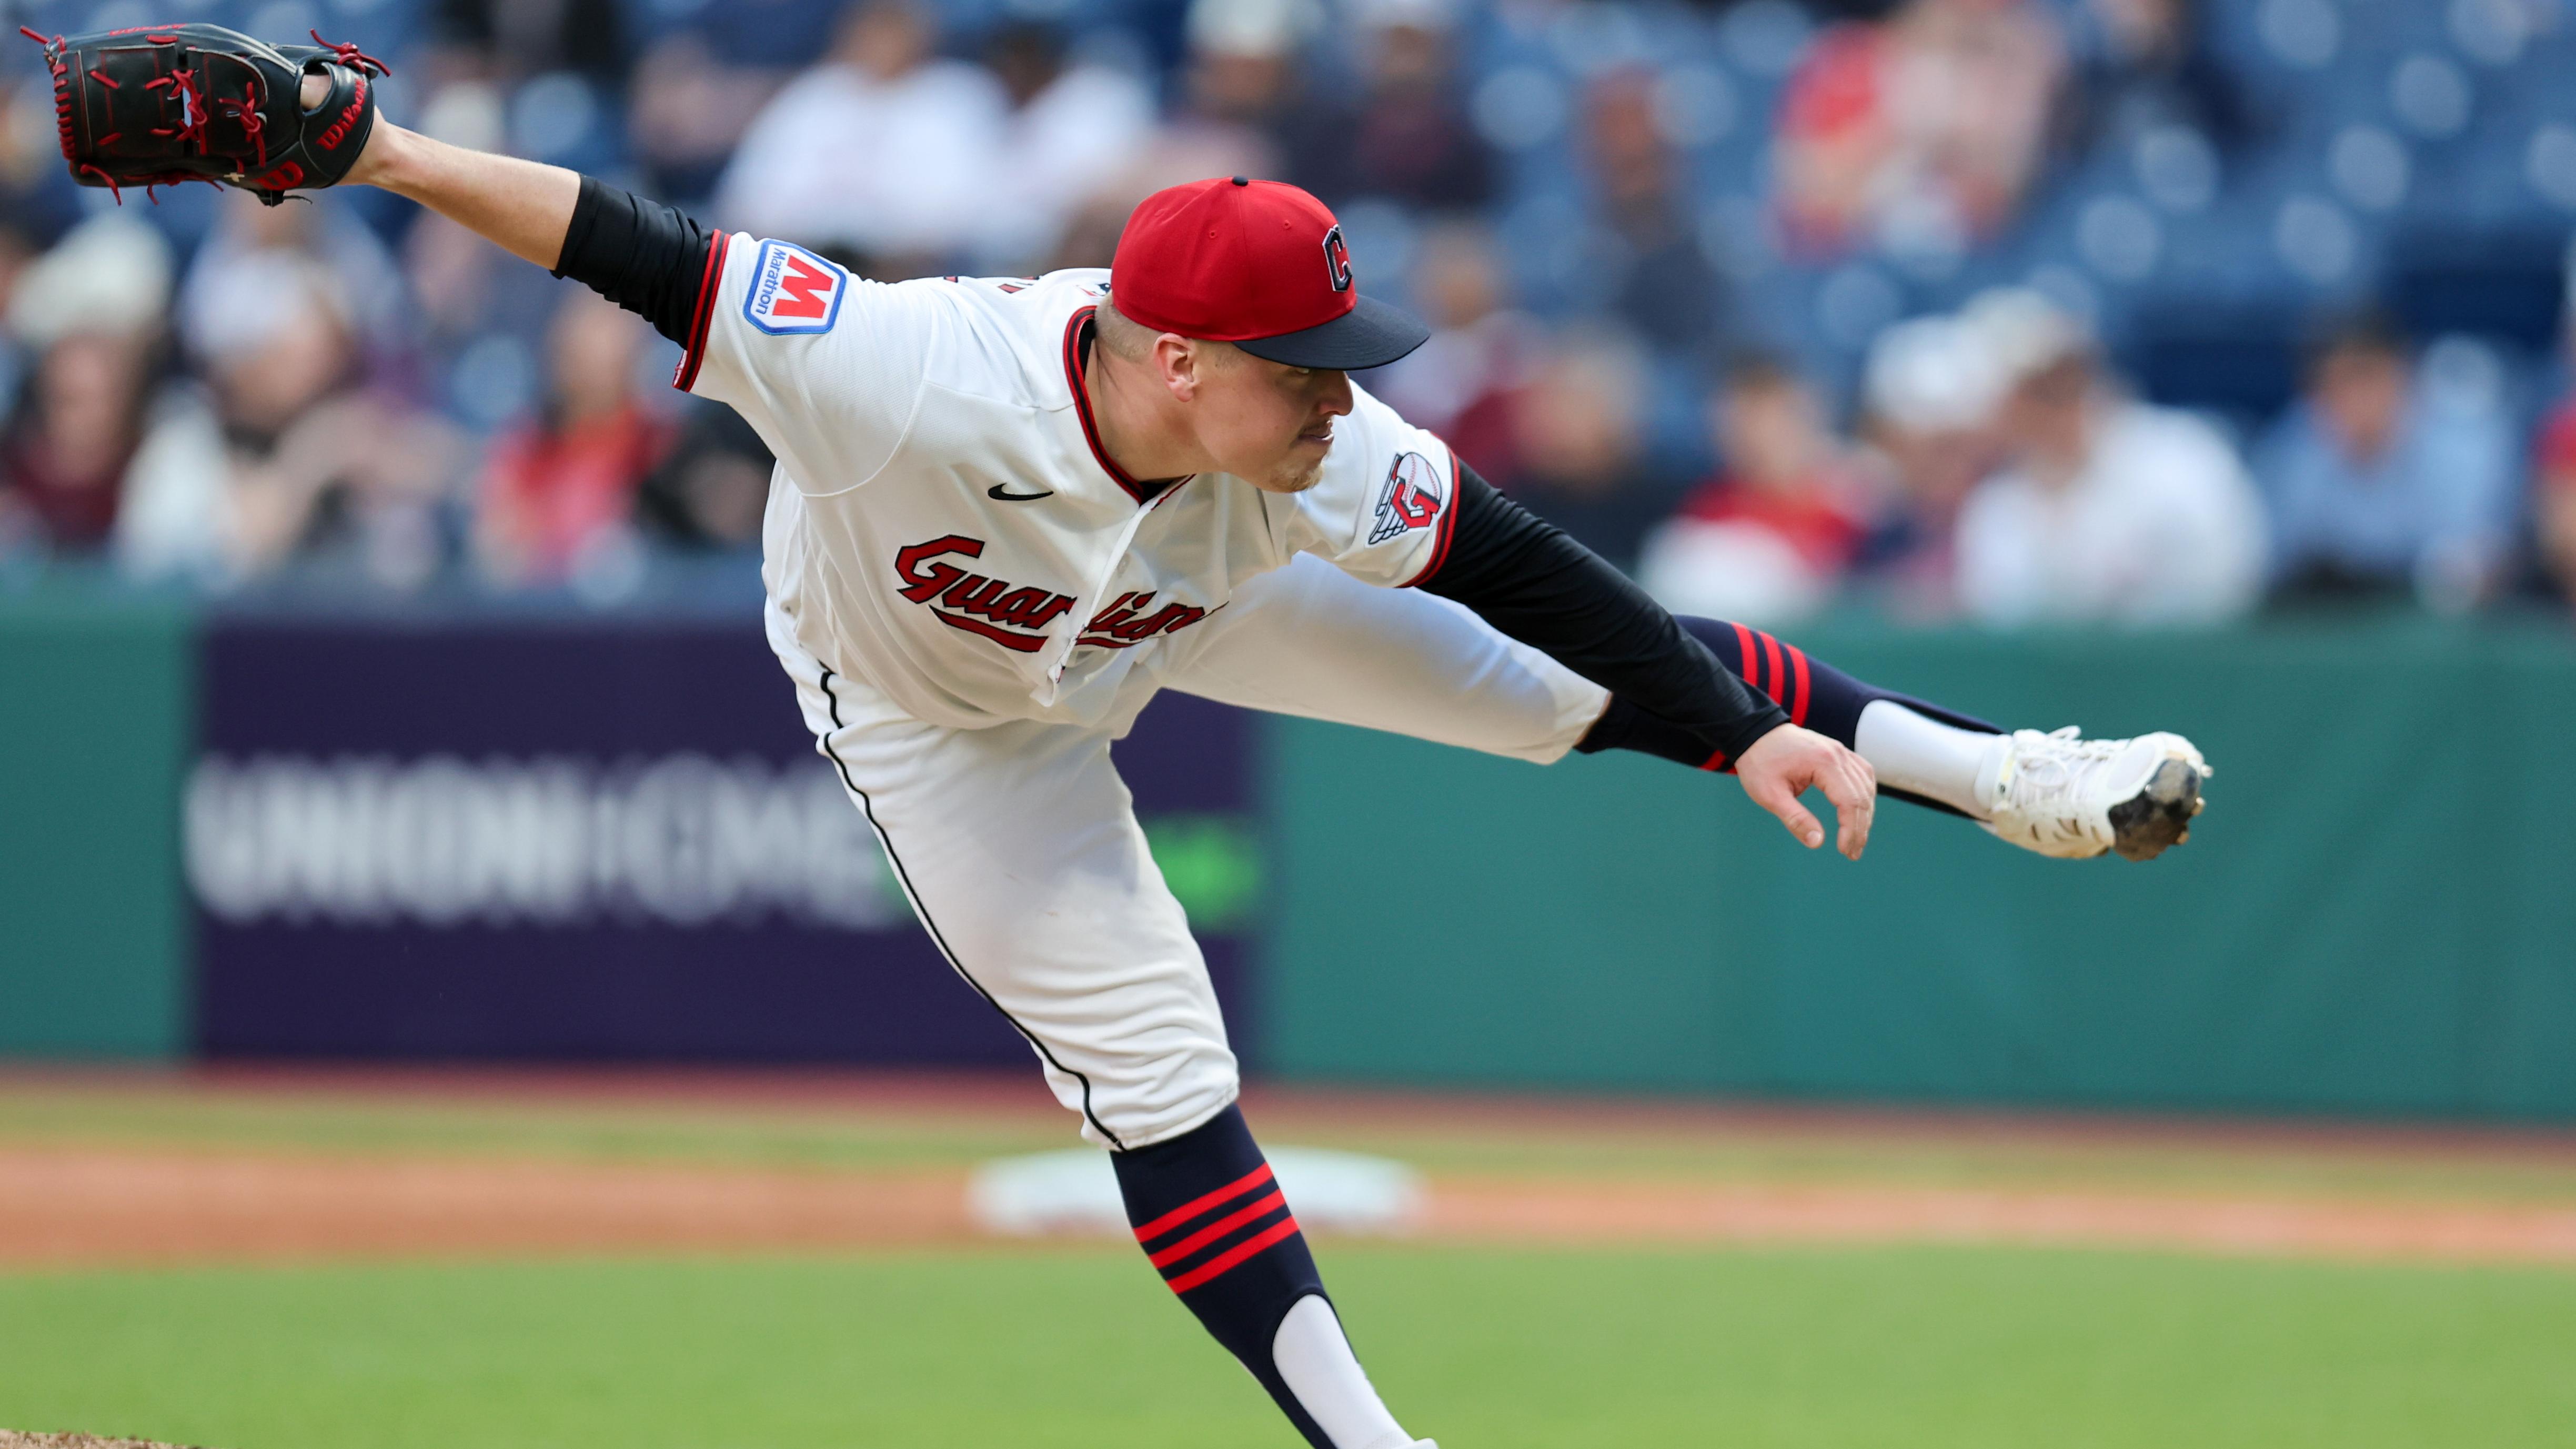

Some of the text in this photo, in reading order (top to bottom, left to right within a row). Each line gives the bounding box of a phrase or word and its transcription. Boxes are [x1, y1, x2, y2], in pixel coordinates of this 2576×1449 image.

[317, 78, 366, 150] Wilson
[756, 247, 787, 315] Marathon
[772, 254, 834, 319] M
[1322, 224, 1352, 292] C
[894, 534, 1230, 641] Guarian
